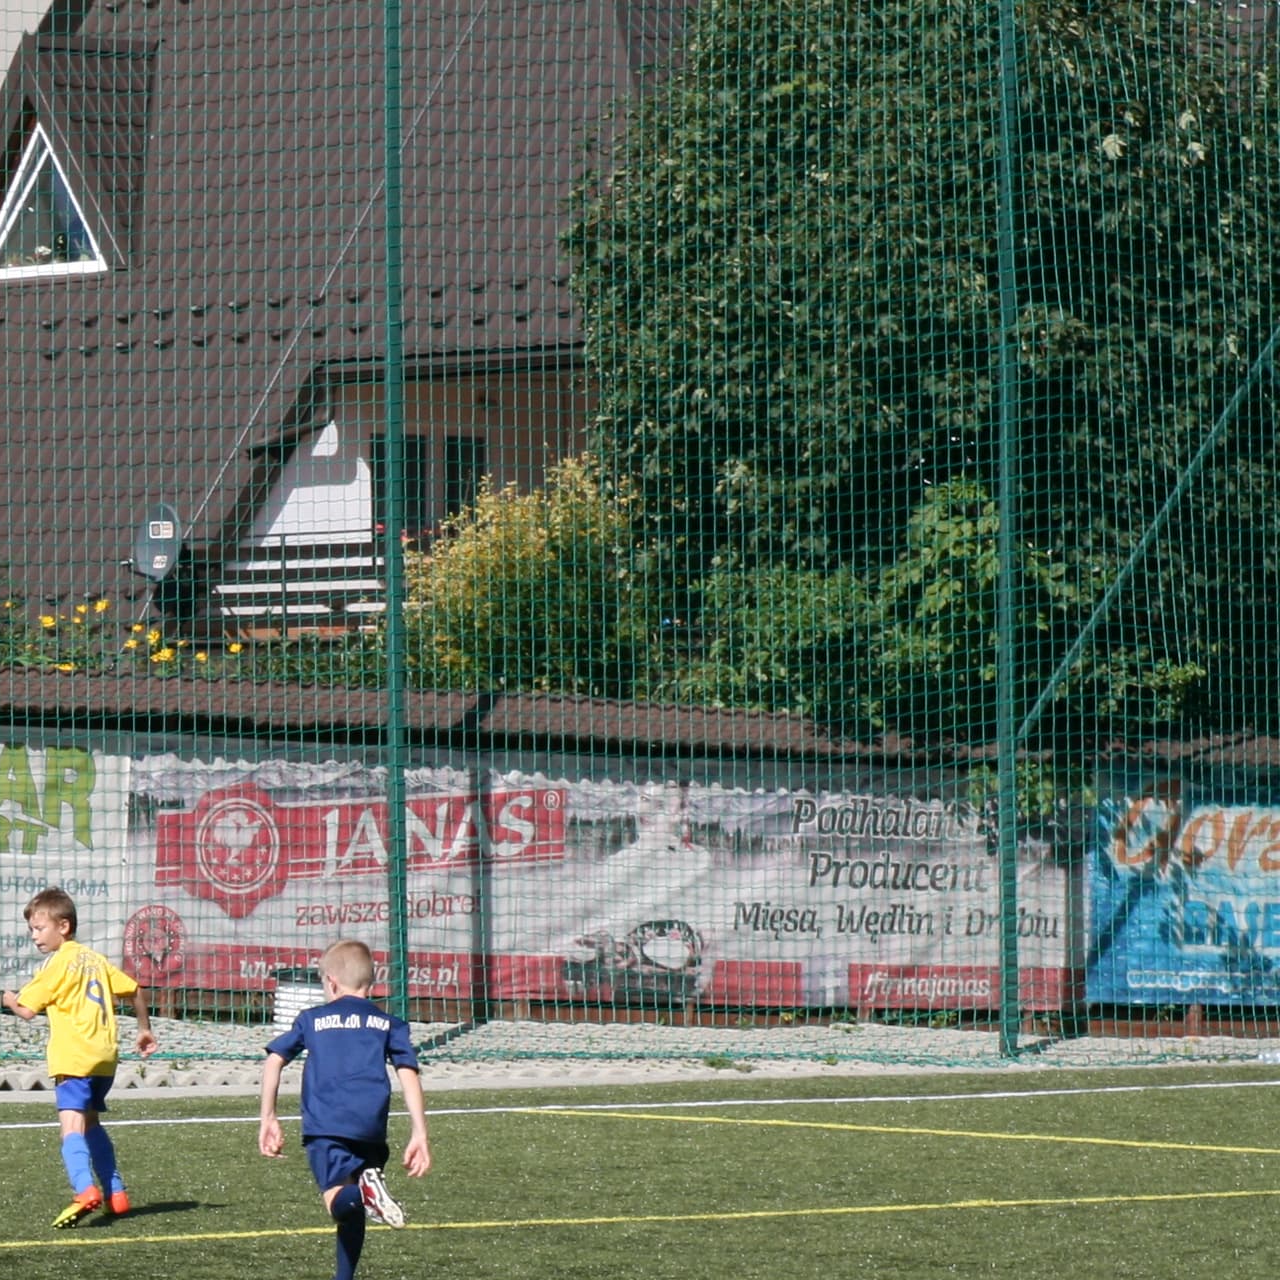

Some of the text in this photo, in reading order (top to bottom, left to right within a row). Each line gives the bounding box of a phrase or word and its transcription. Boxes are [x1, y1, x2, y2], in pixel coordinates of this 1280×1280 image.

[322, 796, 534, 879] JANAS
[59, 878, 110, 897] JOMA
[809, 852, 991, 891] Producent
[296, 901, 390, 926] zawsze
[734, 901, 1059, 944] Mięsa, Wędlin i Drbiu
[86, 979, 107, 1026] 9
